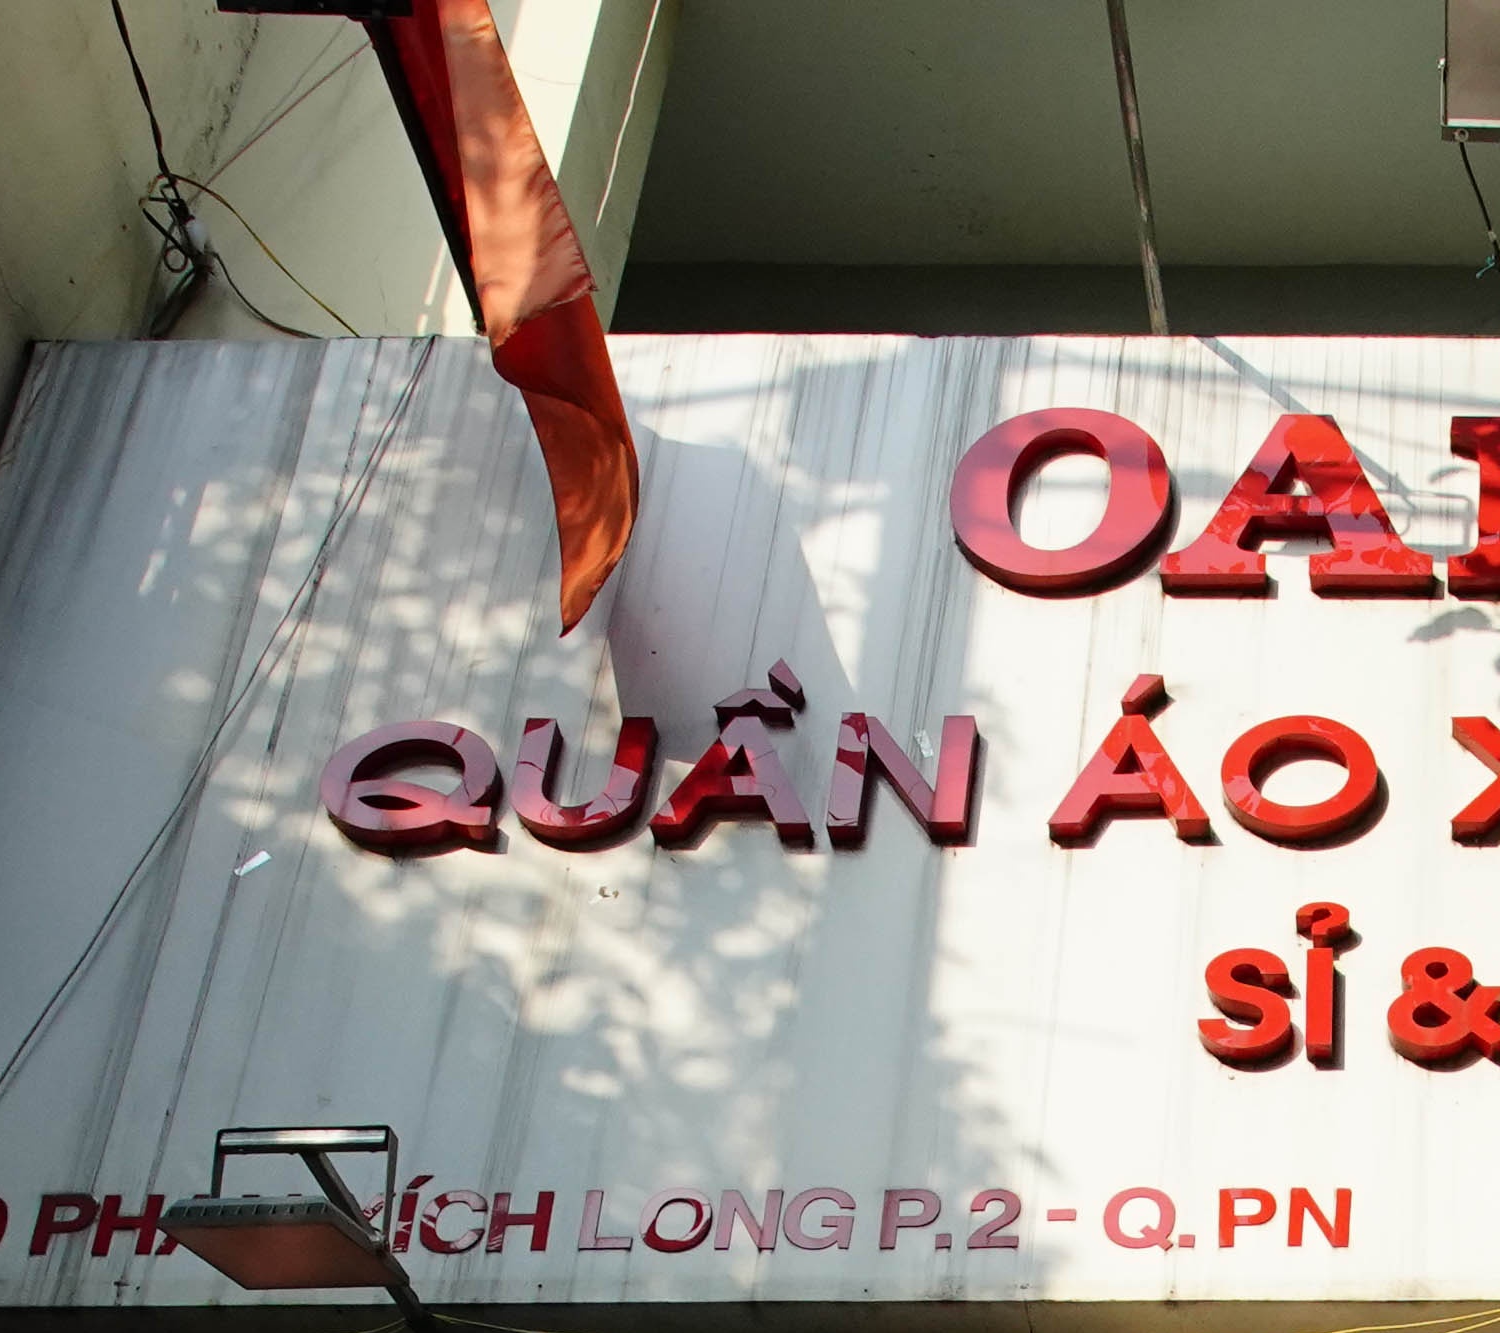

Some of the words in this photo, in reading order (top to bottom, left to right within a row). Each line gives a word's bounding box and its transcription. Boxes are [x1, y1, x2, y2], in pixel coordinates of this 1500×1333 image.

[319, 658, 980, 856] QUẦN
[1048, 674, 1382, 844] ÁO
[1197, 902, 1352, 1066] SỈ
[29, 1192, 302, 1257] PH
[362, 1175, 555, 1254] ÍCH
[578, 1187, 856, 1253] LONG
[879, 1188, 1022, 1250] P.2
